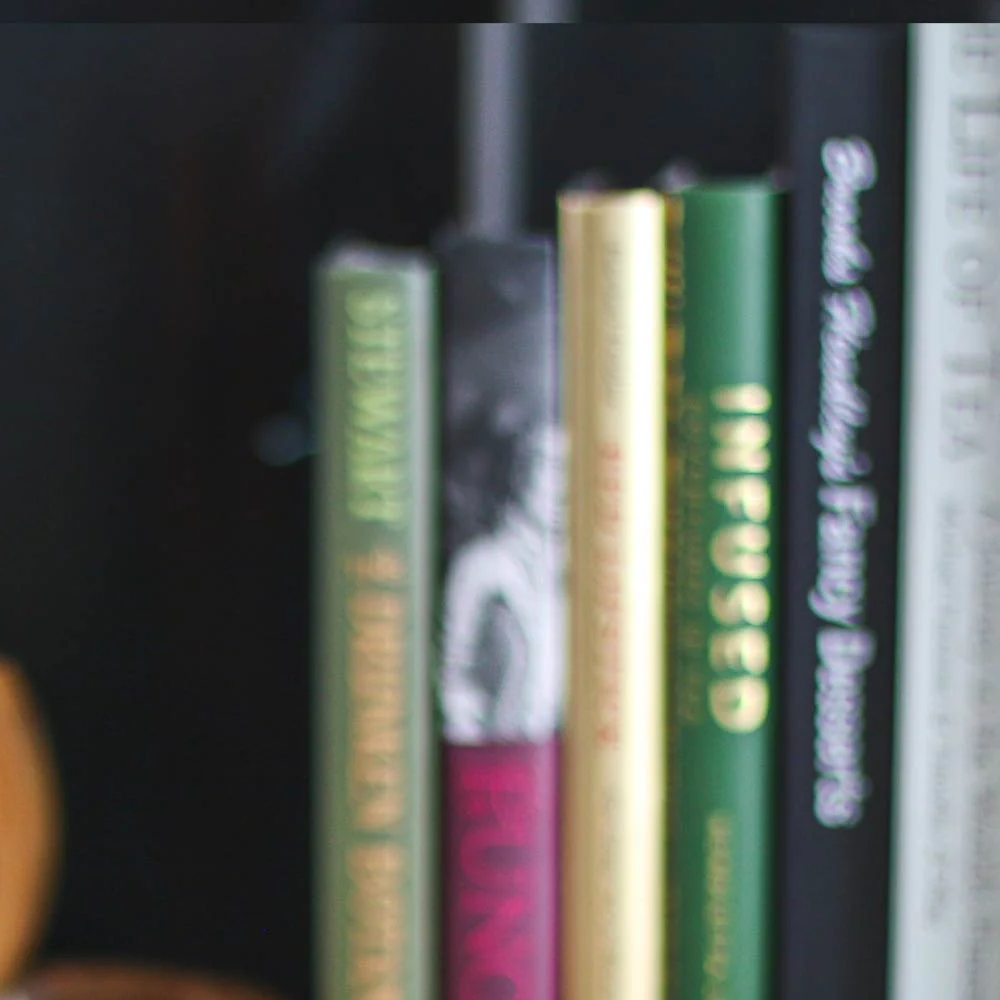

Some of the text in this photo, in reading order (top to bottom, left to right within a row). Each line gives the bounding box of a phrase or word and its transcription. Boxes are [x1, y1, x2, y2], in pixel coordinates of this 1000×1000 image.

[343, 288, 403, 523] STEWART
[708, 382, 771, 733] INFUSED
[808, 483, 877, 628] Fancy
